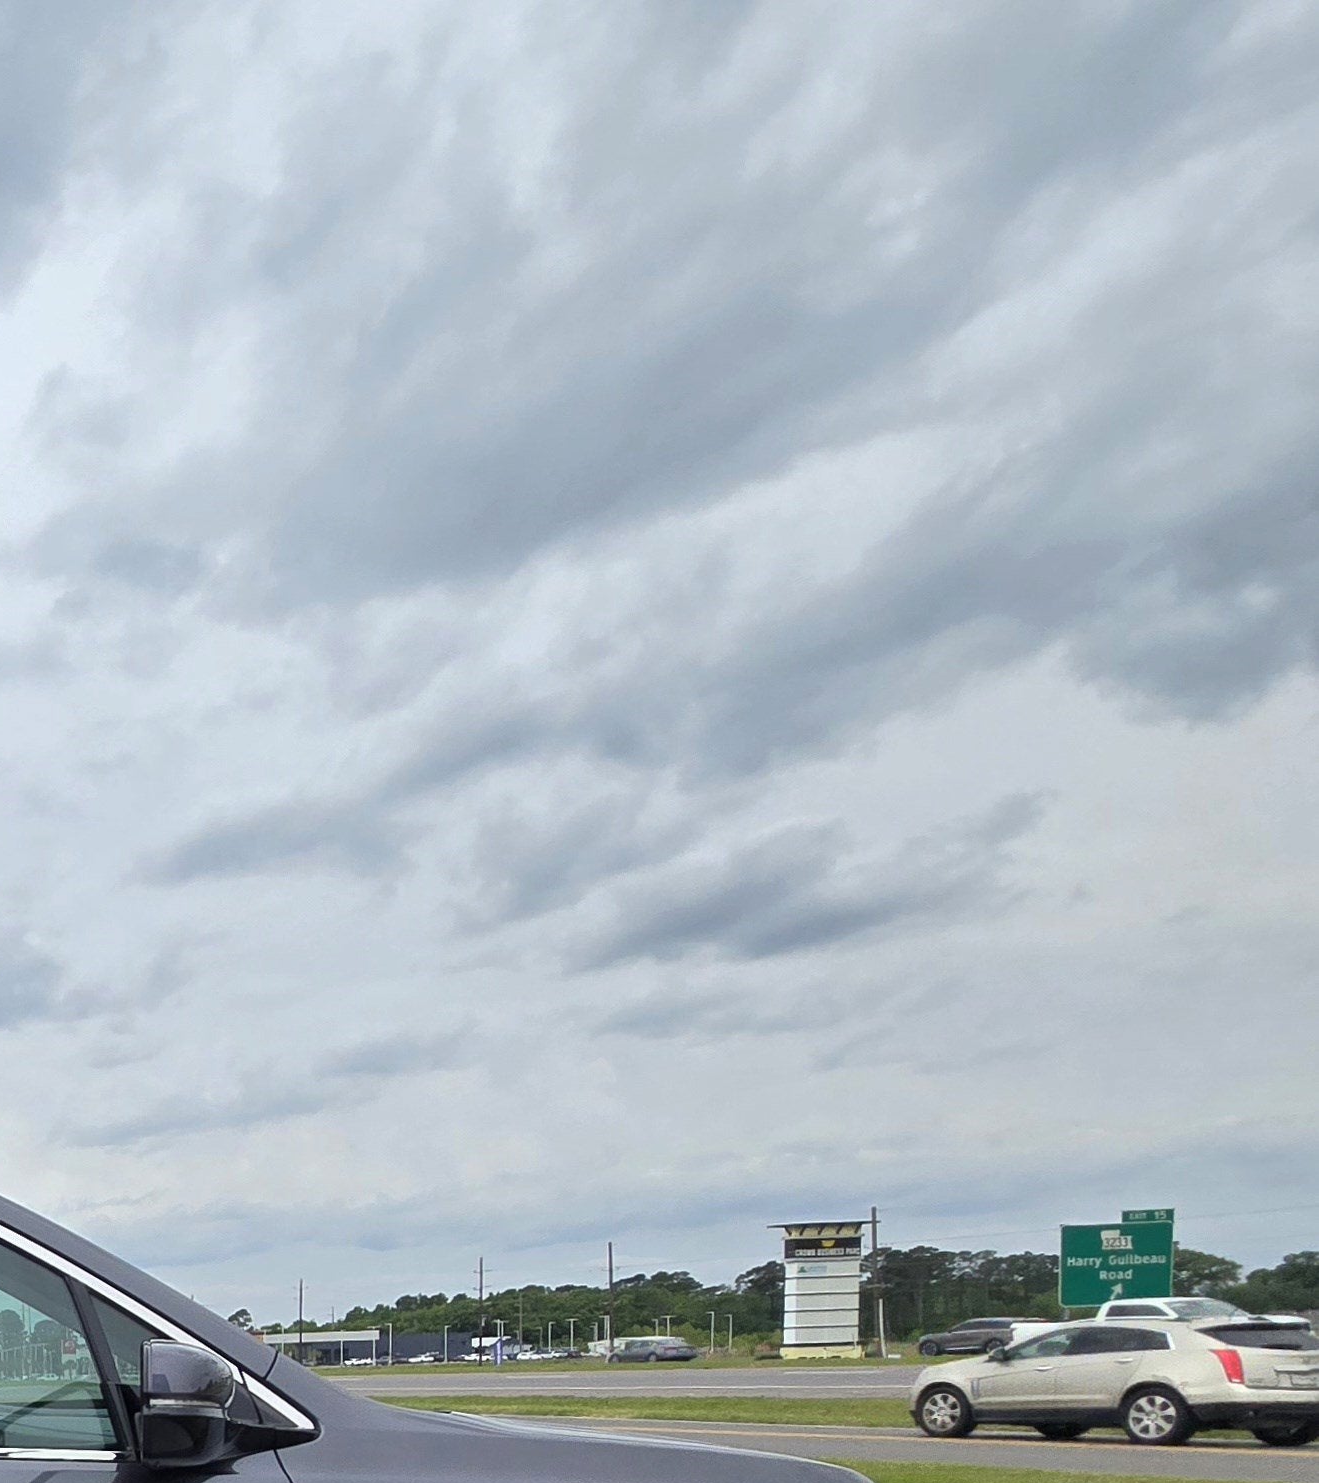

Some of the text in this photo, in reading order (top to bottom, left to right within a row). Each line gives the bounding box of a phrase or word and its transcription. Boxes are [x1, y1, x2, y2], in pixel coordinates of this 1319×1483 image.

[1104, 1237, 1129, 1248] 3233
[1067, 1255, 1103, 1269] Harry
[1099, 1268, 1133, 1280] Road
